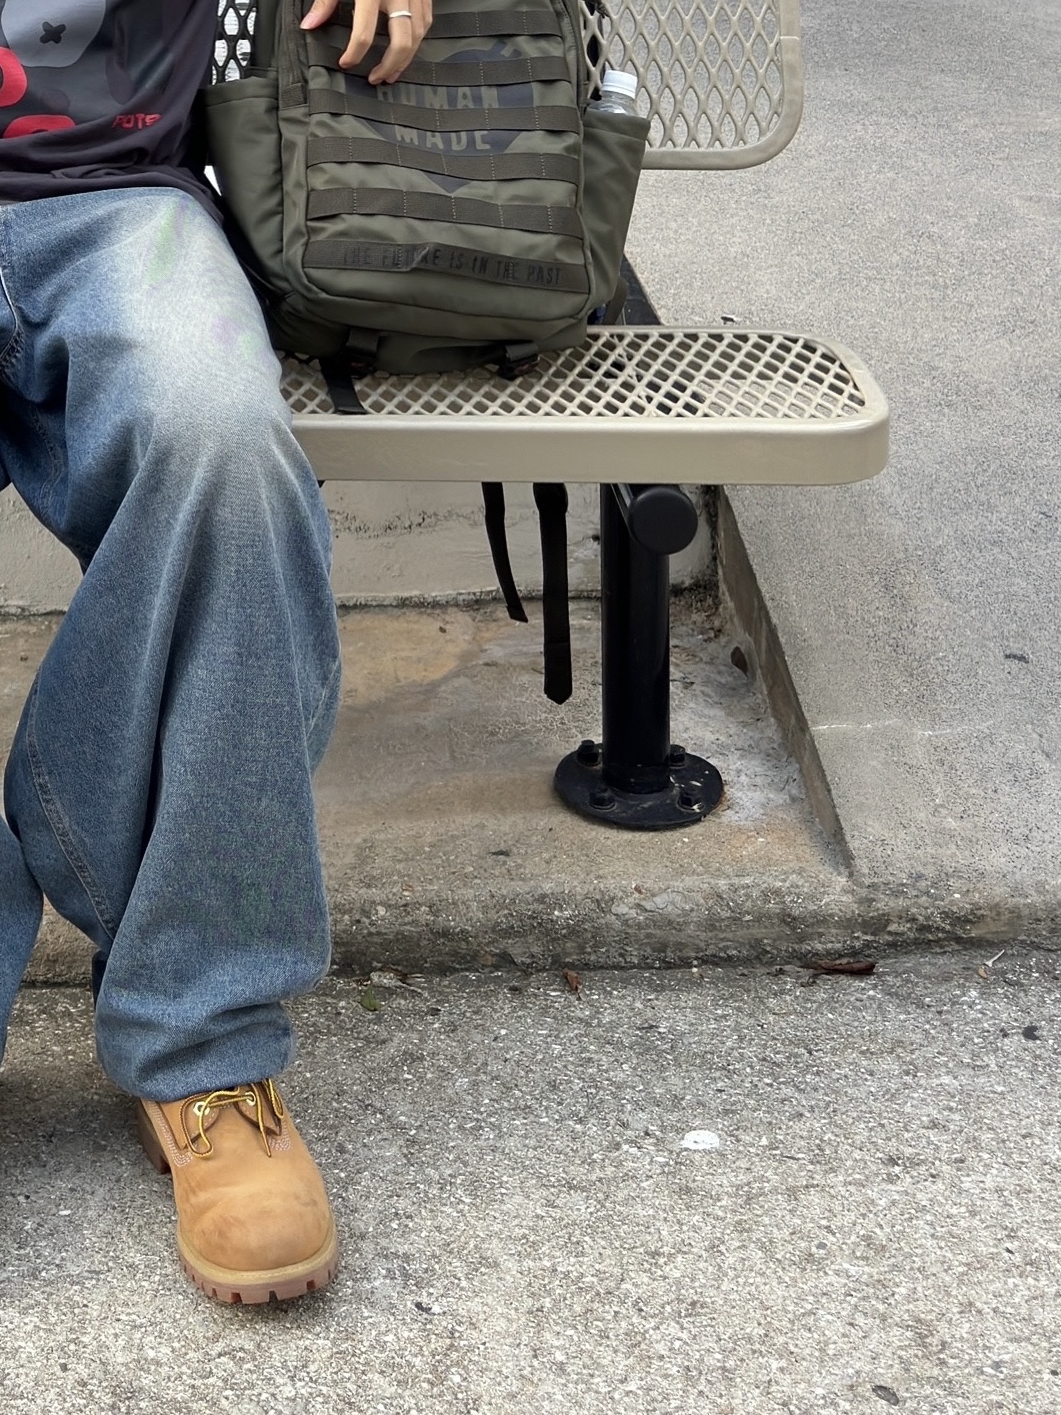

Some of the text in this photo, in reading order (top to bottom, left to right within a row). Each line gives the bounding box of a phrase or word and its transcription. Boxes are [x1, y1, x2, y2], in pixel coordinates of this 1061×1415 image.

[394, 124, 491, 151] MADE
[449, 249, 464, 270] IS
[471, 254, 488, 275] IN
[495, 259, 519, 282] THE
[527, 264, 563, 287] PAST
